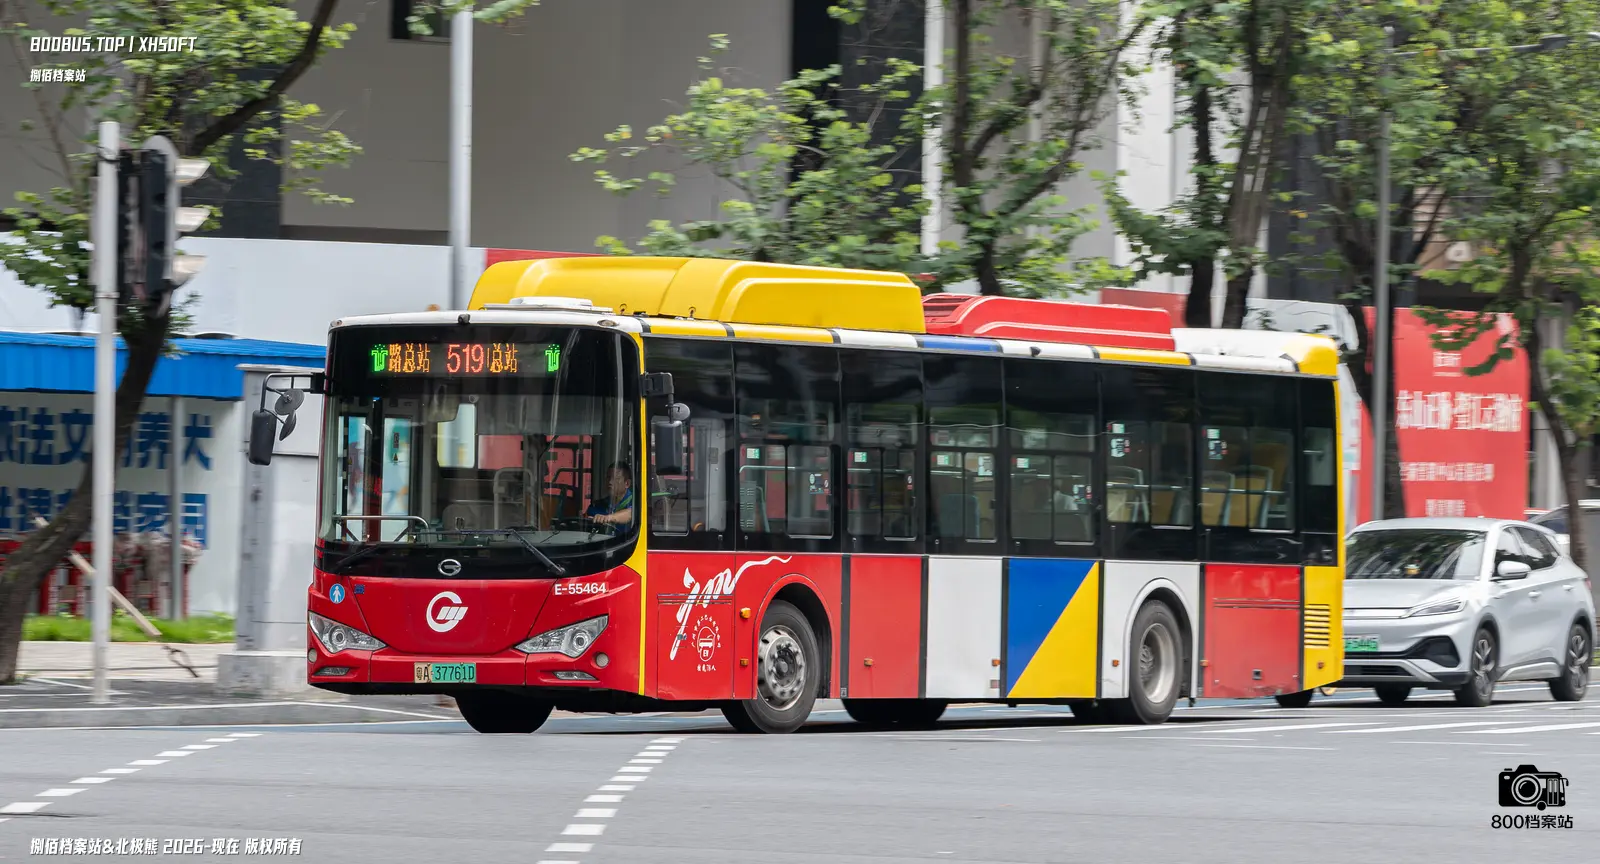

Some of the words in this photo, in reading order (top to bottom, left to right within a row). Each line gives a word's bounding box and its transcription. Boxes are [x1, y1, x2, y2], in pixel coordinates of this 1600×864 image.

[388, 343, 431, 373] 路总站
[446, 343, 485, 373] 519
[486, 343, 518, 373] 总站
[0, 405, 213, 471] 法文养犬
[554, 582, 607, 596] E-55464
